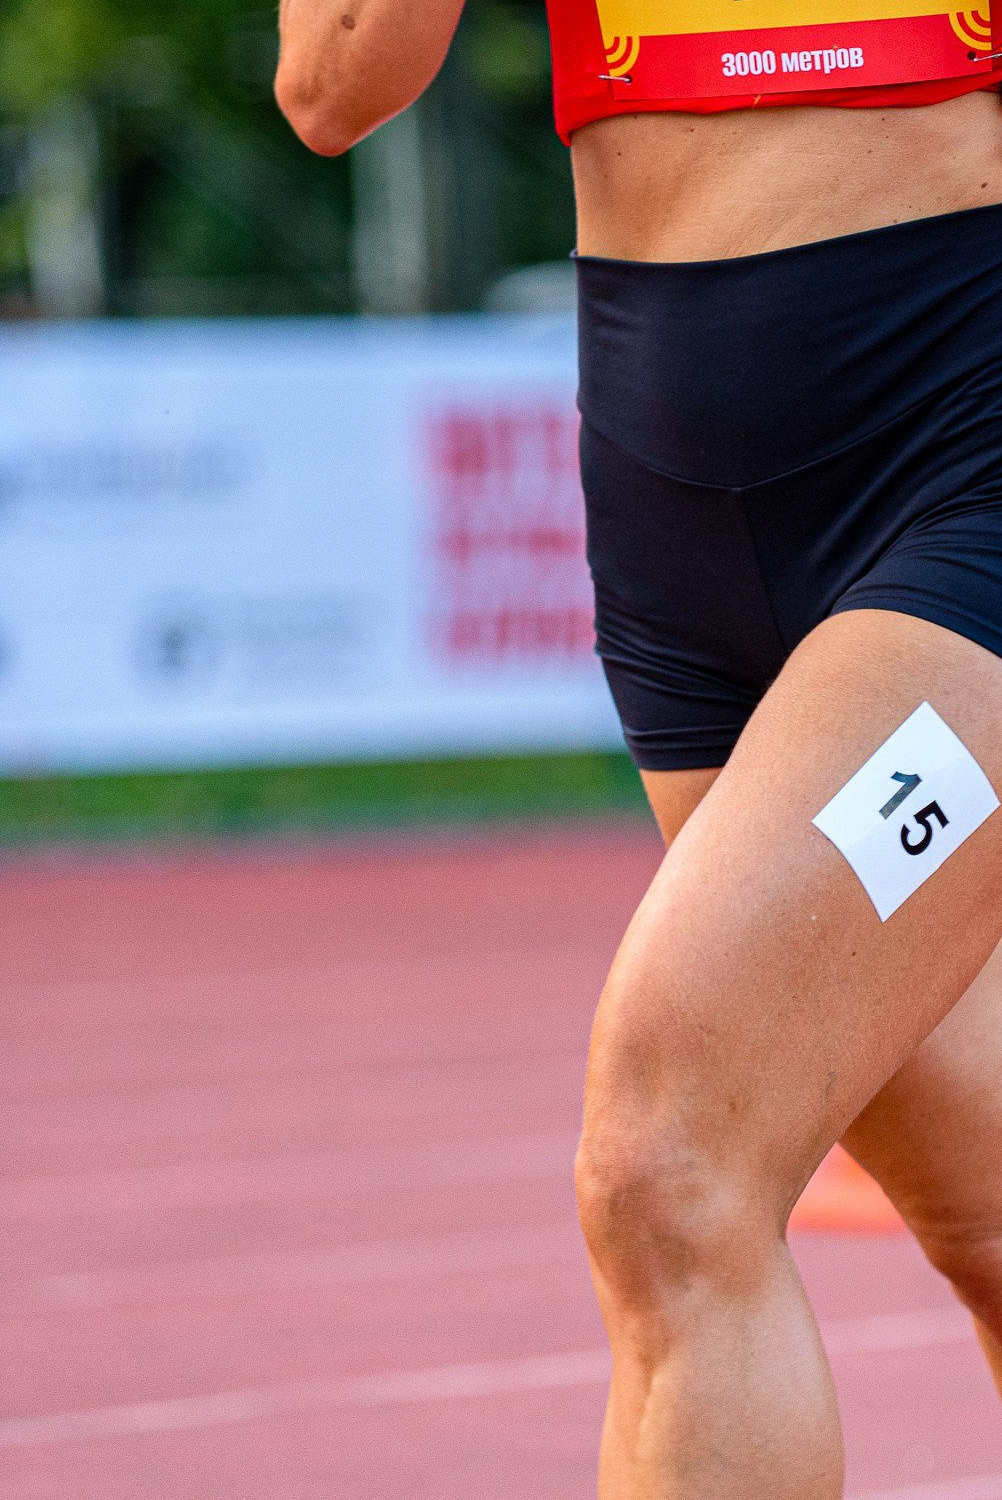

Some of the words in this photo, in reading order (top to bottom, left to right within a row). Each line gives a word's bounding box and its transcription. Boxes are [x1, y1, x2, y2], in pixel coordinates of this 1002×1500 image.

[721, 50, 776, 77] 3000
[781, 47, 865, 74] метров
[878, 771, 950, 856] 15
